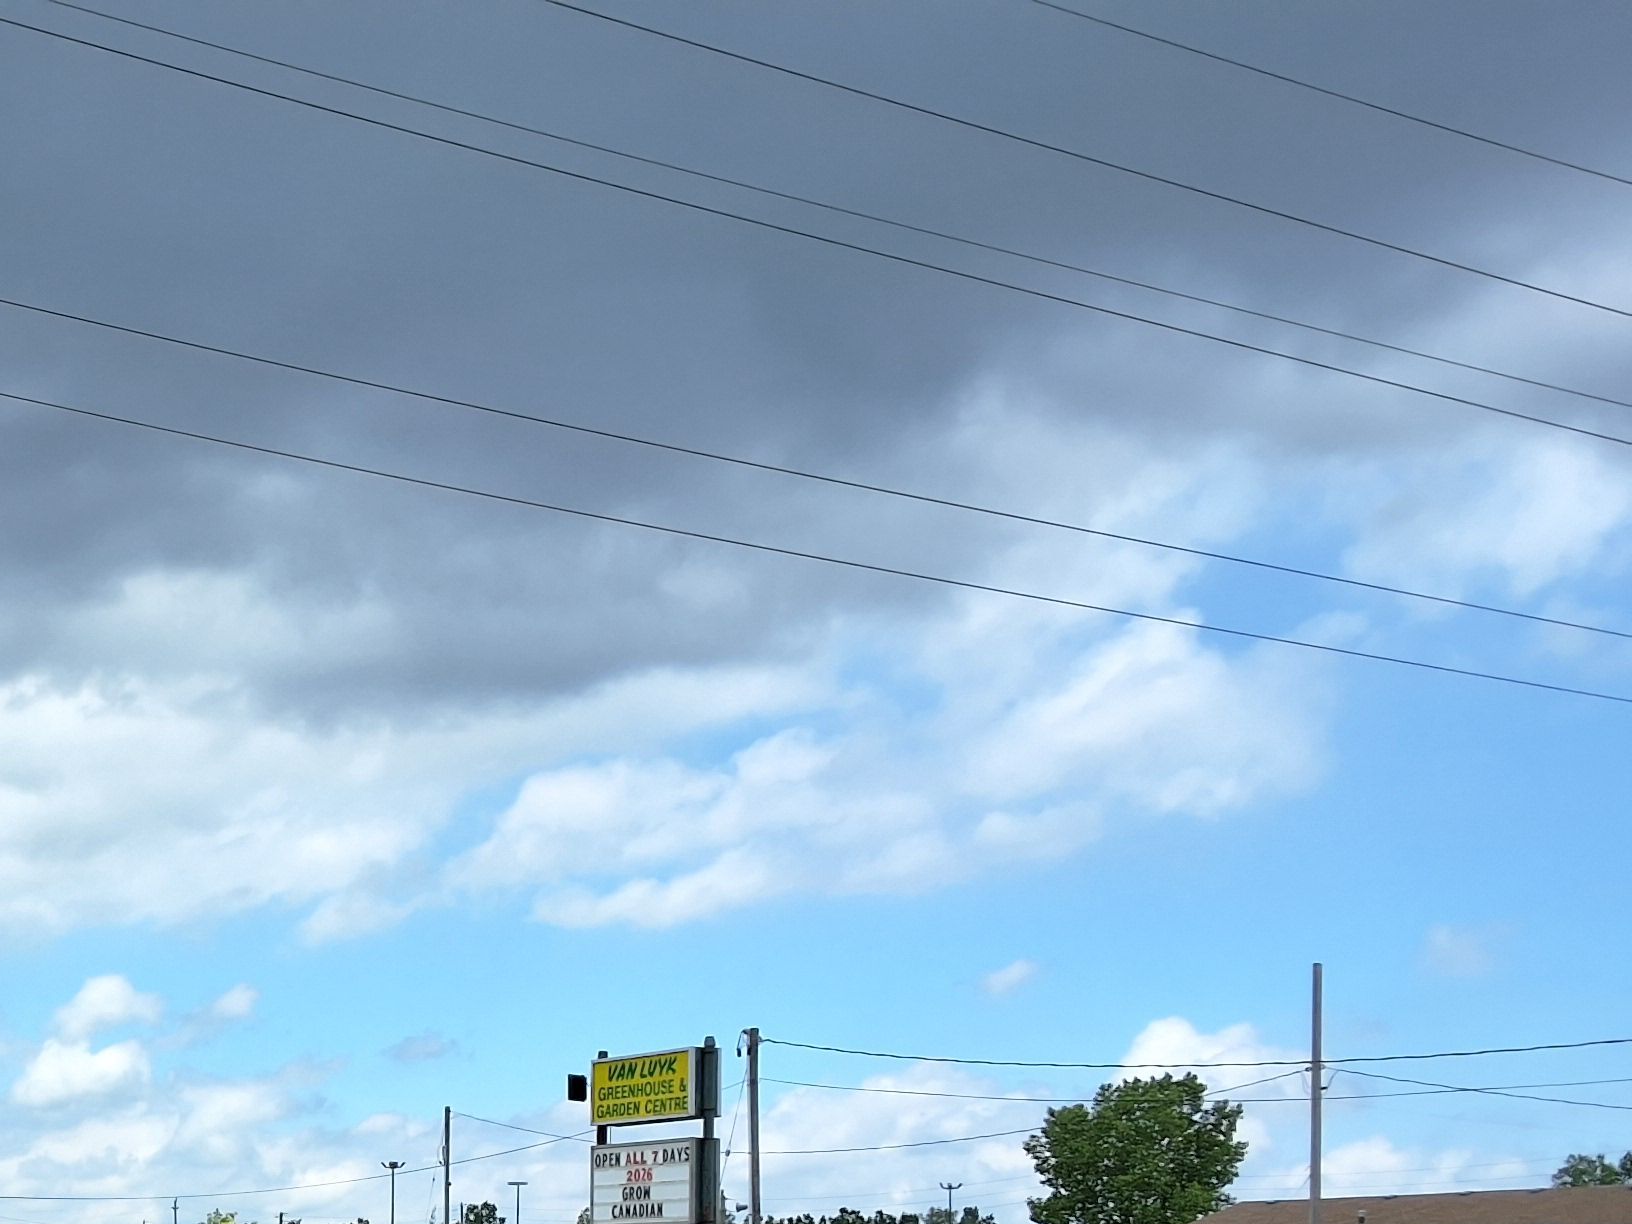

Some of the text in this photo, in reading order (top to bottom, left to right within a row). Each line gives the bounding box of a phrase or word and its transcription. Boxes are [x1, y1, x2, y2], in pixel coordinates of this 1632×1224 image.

[608, 1056, 677, 1082] VAN LUYK
[598, 1077, 687, 1101] GREENHOUSE &
[596, 1096, 688, 1118] GARDEN CENTRE
[595, 1147, 690, 1167] OPEN ALL 7 DAYS
[626, 1168, 653, 1182] 2026
[622, 1186, 651, 1201] GROW
[611, 1203, 663, 1219] CANADIAN
